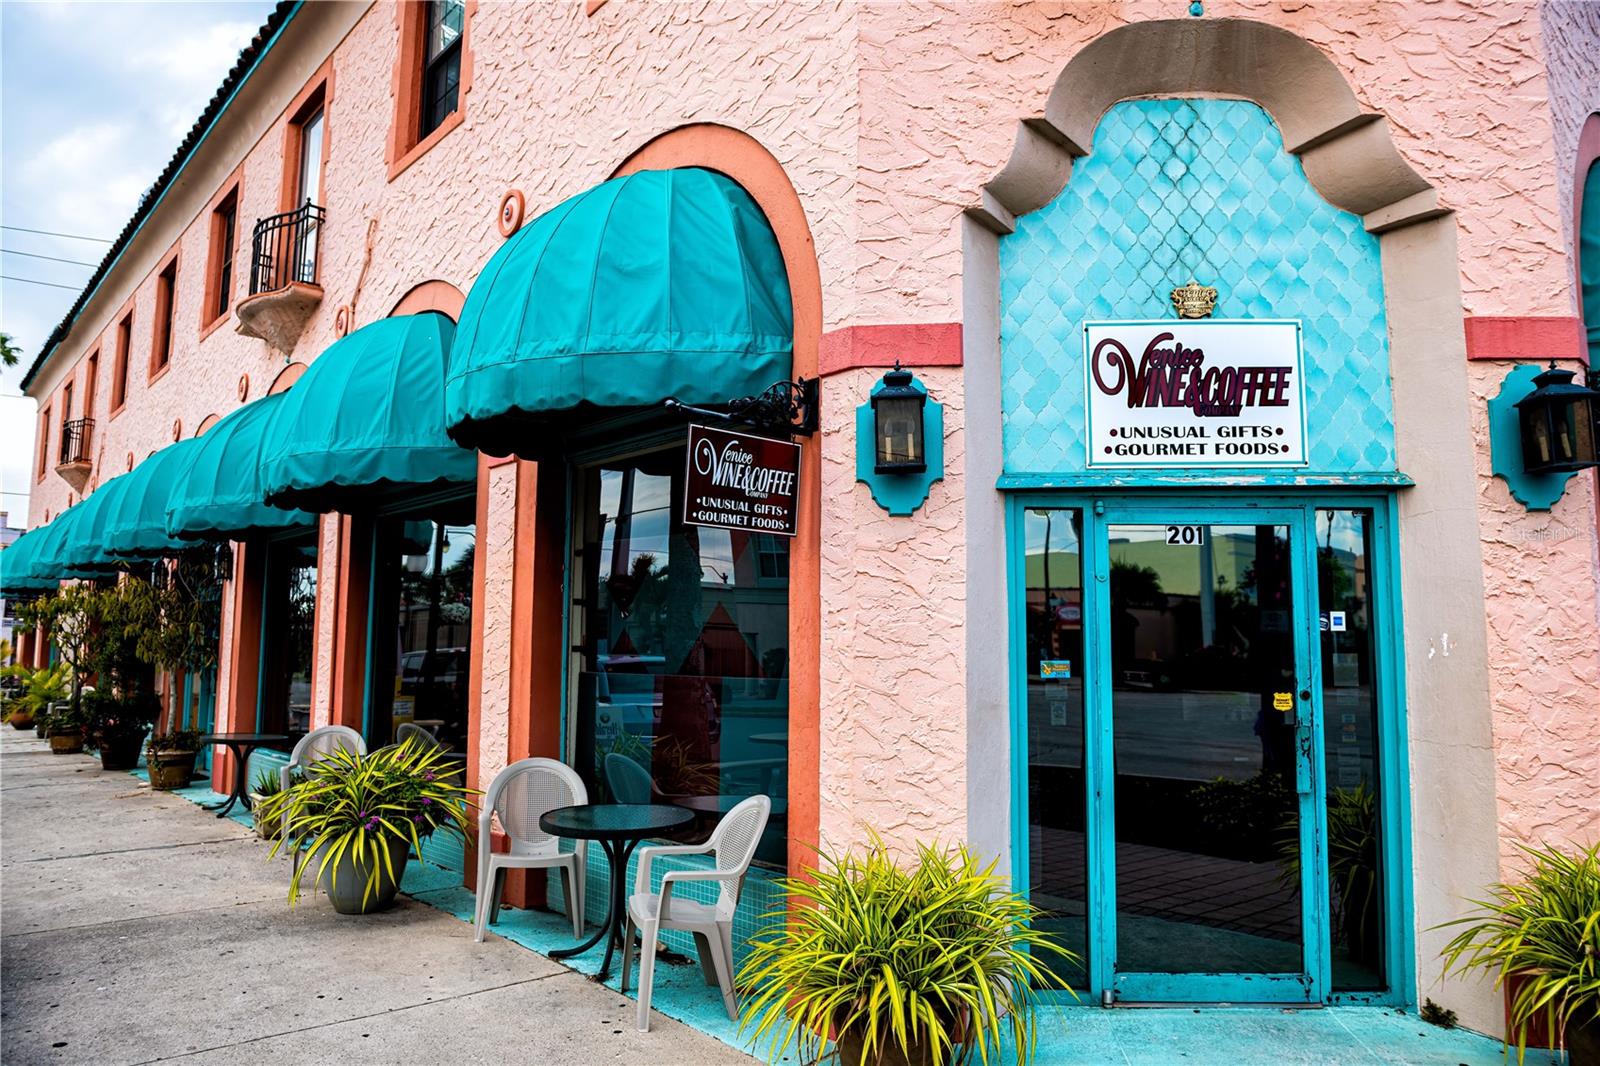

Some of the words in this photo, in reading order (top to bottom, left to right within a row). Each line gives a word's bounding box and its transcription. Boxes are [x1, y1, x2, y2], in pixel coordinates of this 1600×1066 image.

[1092, 332, 1204, 408] Venice
[1120, 426, 1211, 439] UNUSUAL
[1217, 425, 1273, 438] GIFTS
[1114, 443, 1208, 456] GOURMET
[1215, 443, 1279, 455] FOODS
[694, 438, 753, 486] Venice
[702, 496, 751, 512] UNUSUAL
[754, 504, 783, 516] GIFTS
[698, 511, 749, 526] GOURMET
[751, 517, 785, 530] FOODS
[1167, 525, 1203, 545] 201
